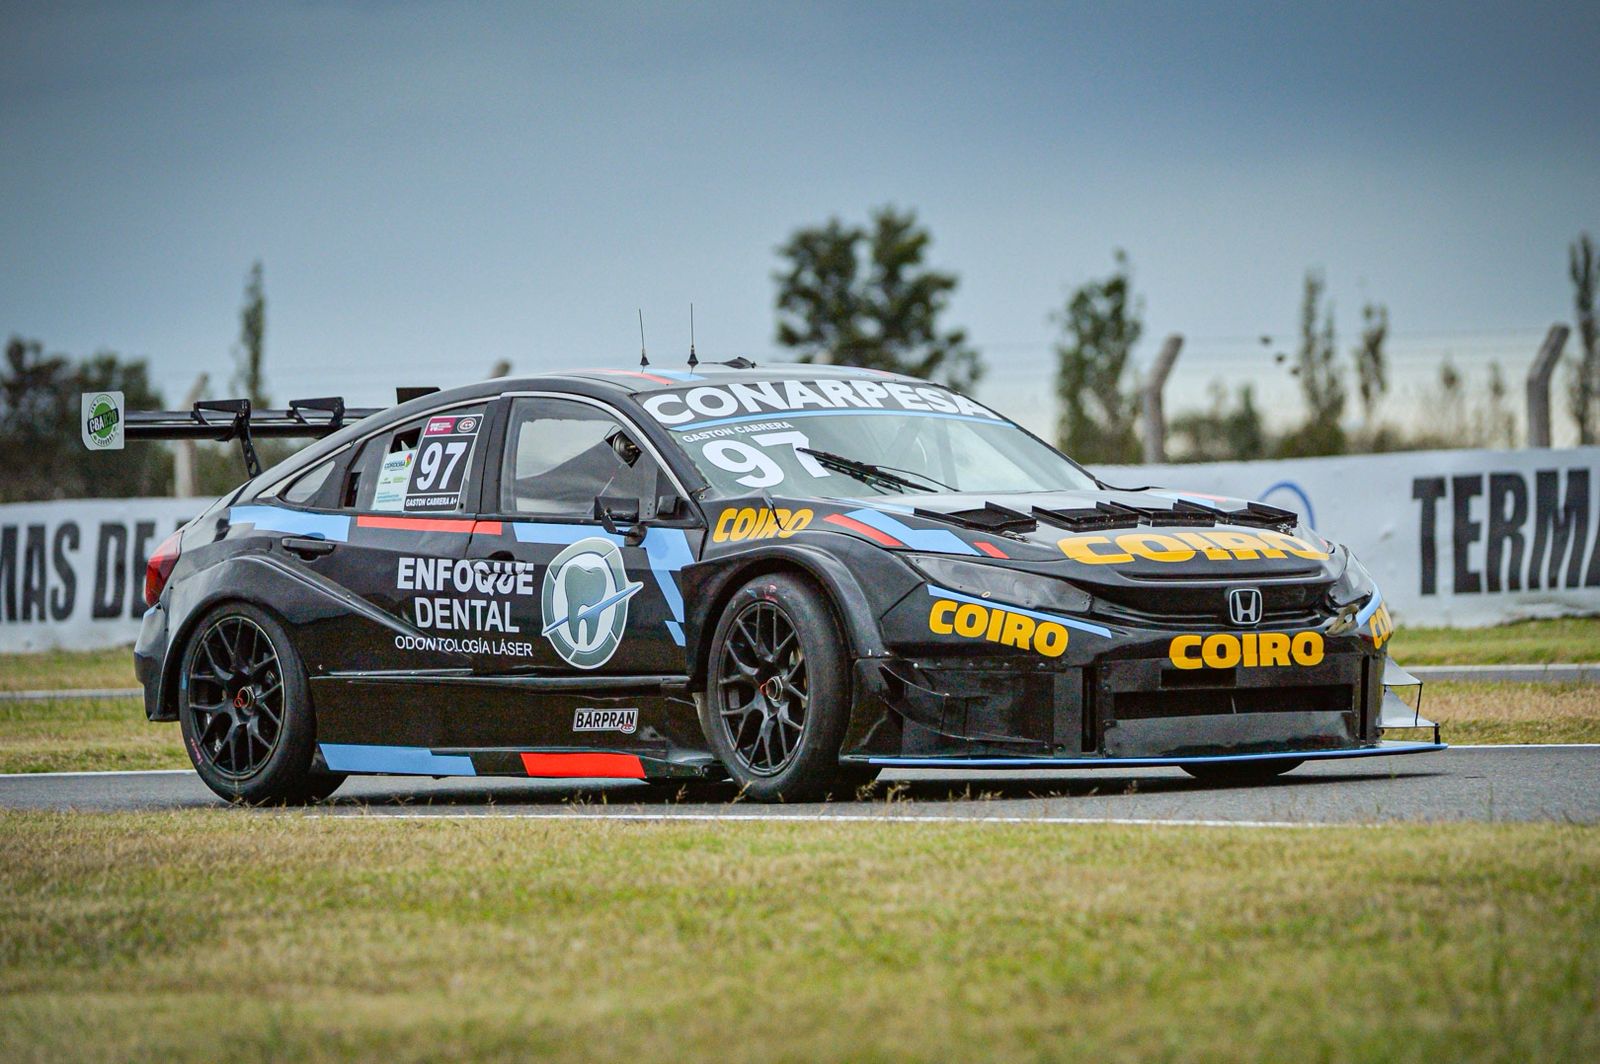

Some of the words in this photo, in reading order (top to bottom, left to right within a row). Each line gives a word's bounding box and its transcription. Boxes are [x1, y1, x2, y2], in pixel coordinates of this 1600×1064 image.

[643, 379, 1002, 424] CONARPESA
[682, 428, 734, 443] GASTON
[735, 421, 795, 434] CABRERA
[416, 442, 468, 490] 97
[701, 431, 832, 488] 97
[406, 498, 426, 507] GASTON
[426, 496, 450, 506] CABRERA
[712, 507, 814, 543] COIRO
[1413, 468, 1600, 597] TERM
[1057, 532, 1329, 565] COIRO
[397, 557, 534, 595] ENFOQUE
[414, 597, 520, 633] DENTAL
[929, 599, 1069, 658] COIRO
[395, 635, 490, 654] ODONTOLOGÍA
[492, 640, 533, 657] LÁSER
[1169, 631, 1325, 670] COIRO
